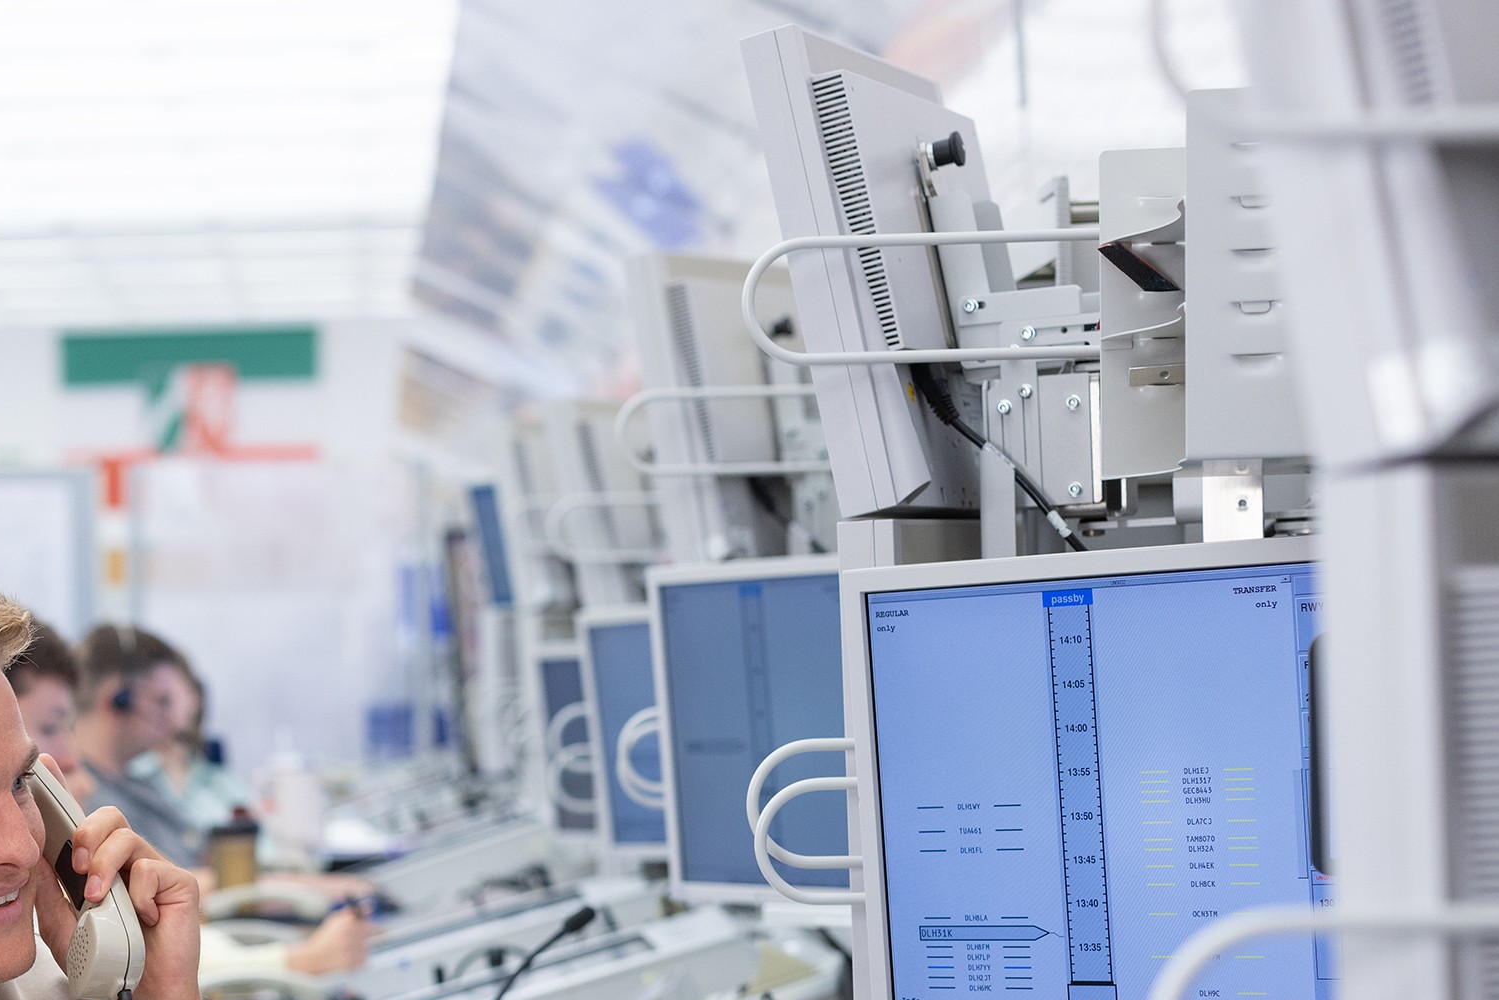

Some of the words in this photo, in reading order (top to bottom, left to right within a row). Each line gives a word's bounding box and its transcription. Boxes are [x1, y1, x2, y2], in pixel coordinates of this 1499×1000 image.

[1233, 585, 1277, 595] TRANSFER
[1051, 593, 1085, 605] passby
[1255, 600, 1277, 609] only
[876, 609, 909, 618] REGULAR
[877, 625, 896, 633] only
[1059, 635, 1082, 644] 14:10
[1062, 680, 1085, 689] 14:05
[1065, 724, 1088, 732] 14:00
[1068, 767, 1090, 776] 13:55
[1185, 796, 1211, 805] DLH3HU
[1070, 812, 1093, 821] 13:50
[1188, 845, 1214, 853] DLH32A
[1073, 855, 1096, 864] 13:45
[1189, 861, 1215, 870] DLH4EK
[1190, 880, 1216, 888] DLH8CK
[1076, 899, 1099, 908] 13:40
[964, 914, 988, 922] DLH8LA
[921, 928, 953, 938] DLH31K
[1079, 943, 1101, 952] 13:35
